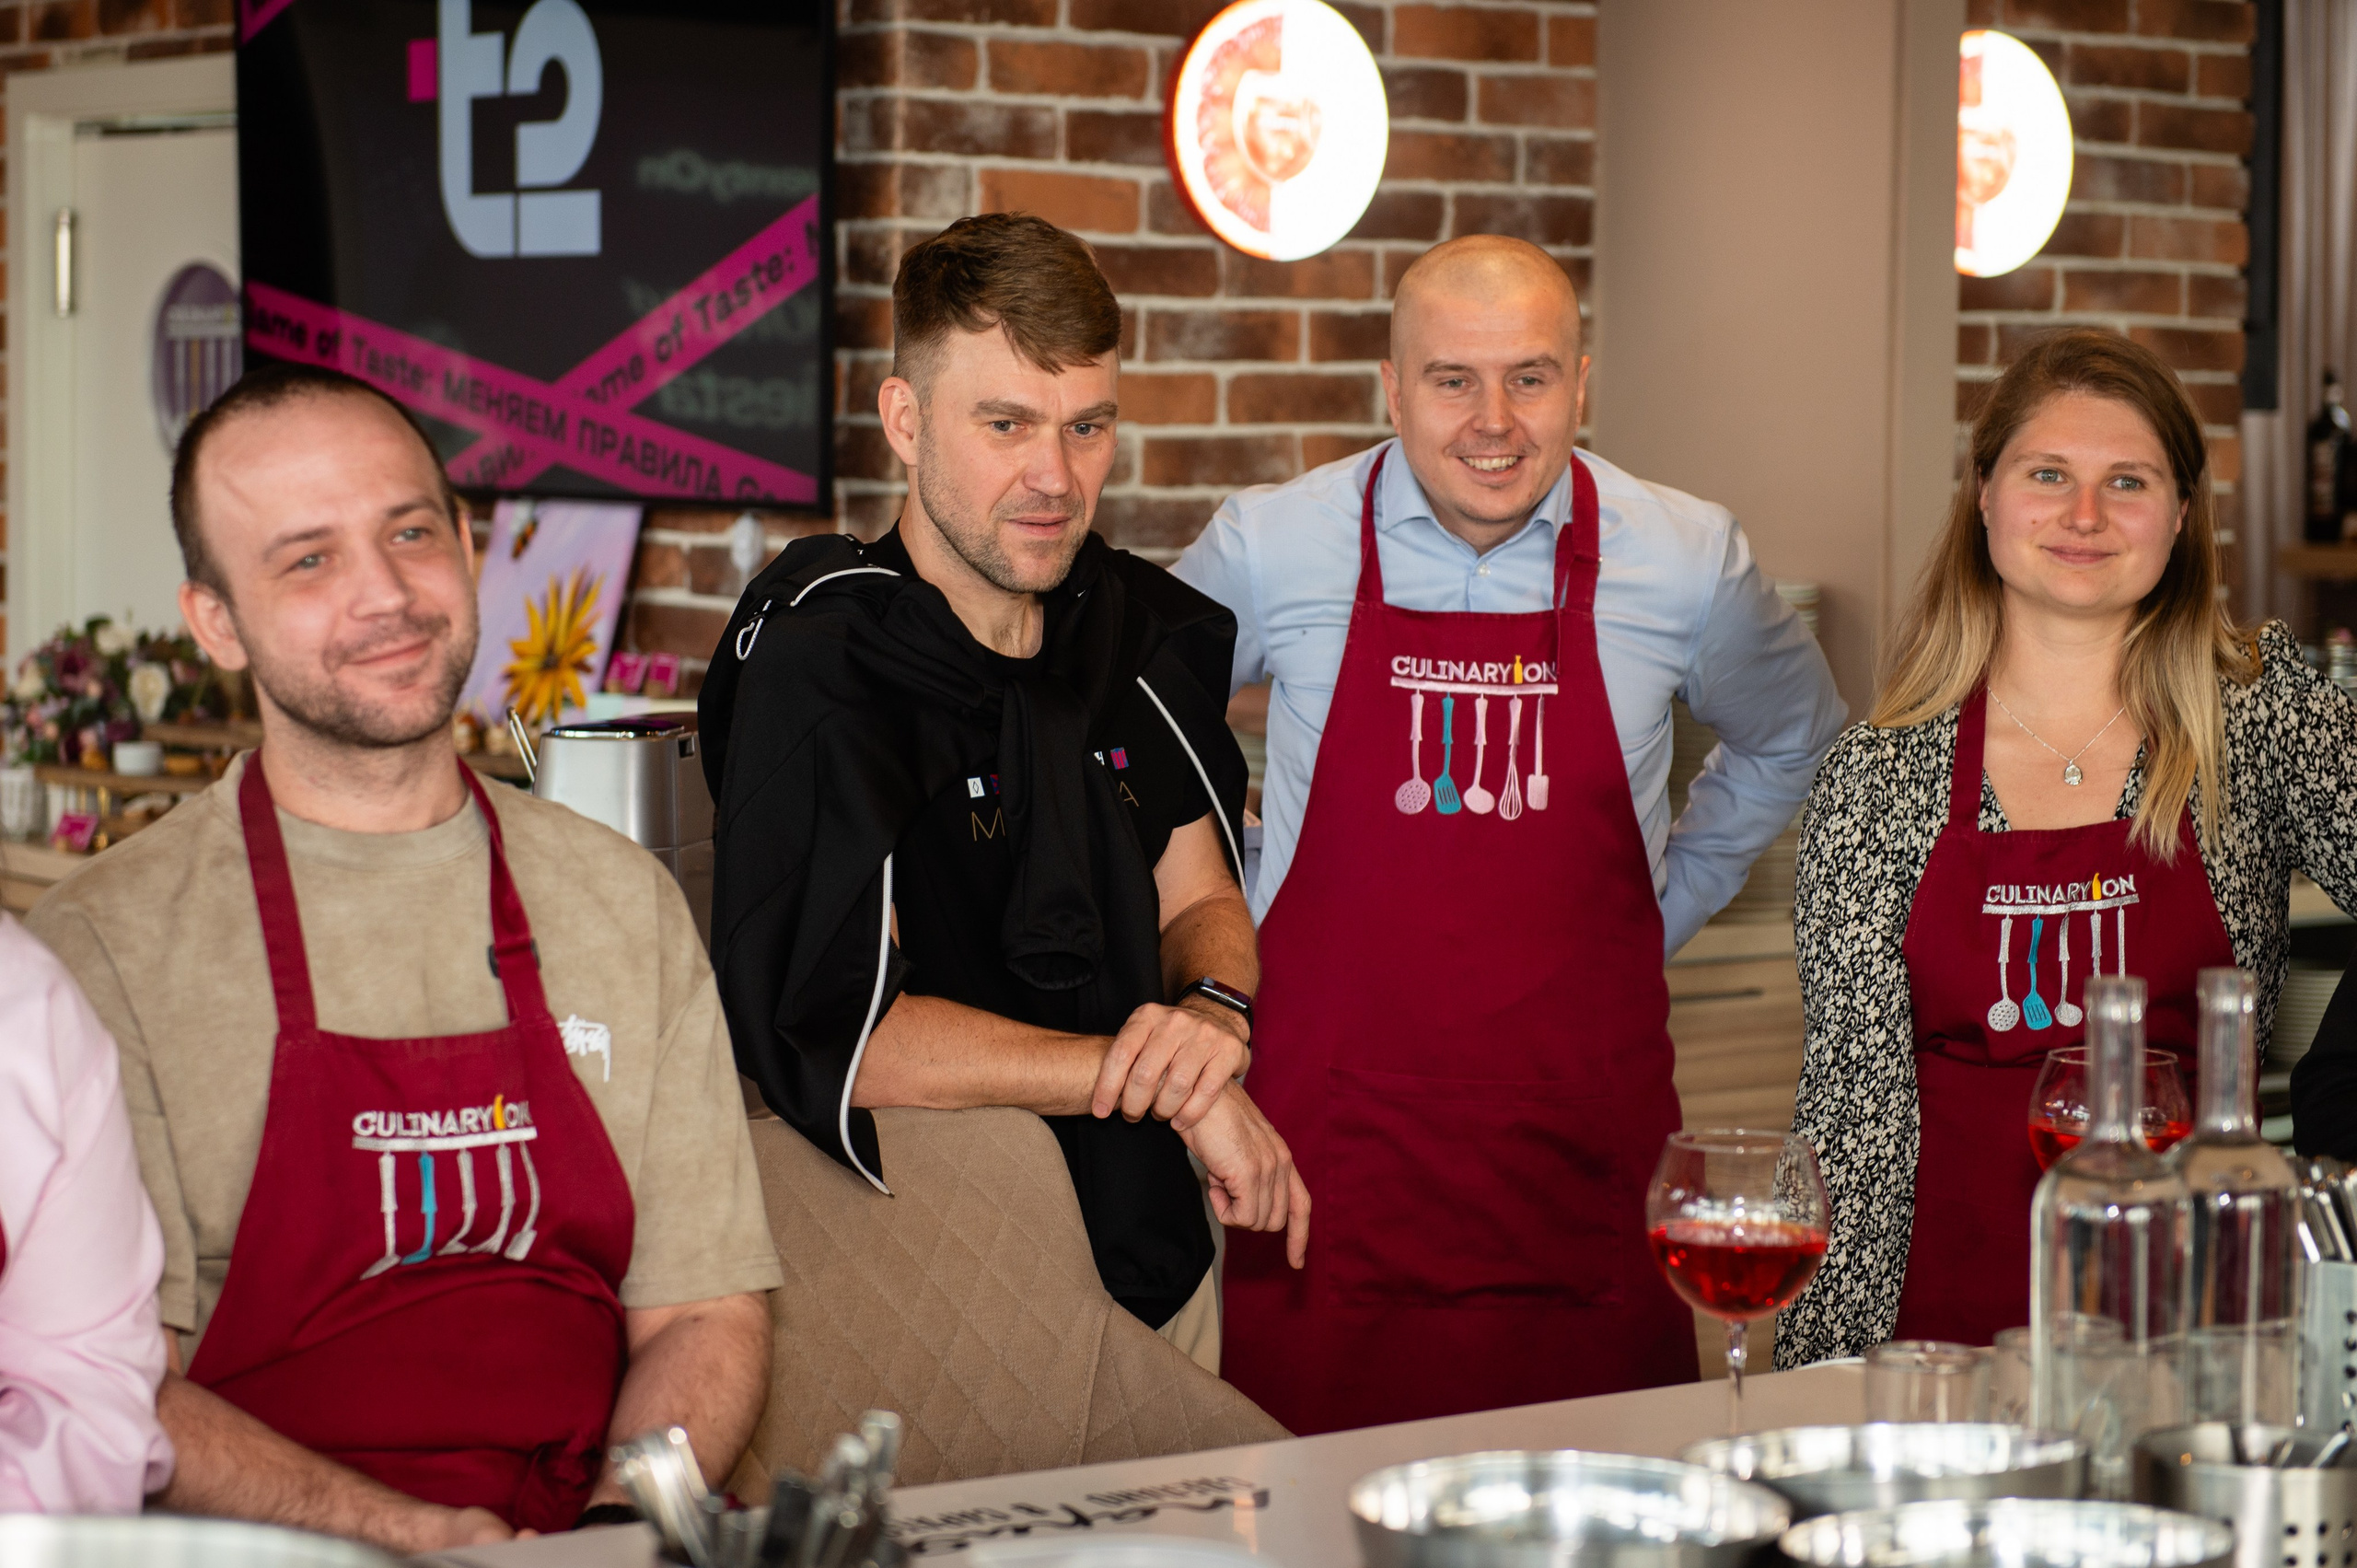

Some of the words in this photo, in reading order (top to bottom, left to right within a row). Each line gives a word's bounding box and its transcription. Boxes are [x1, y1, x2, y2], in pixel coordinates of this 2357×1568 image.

[573, 354, 645, 405] ame
[655, 312, 684, 365] of
[693, 245, 795, 333] Taste:
[316, 328, 342, 359] of
[443, 370, 567, 447] МЕНЯЕМ
[576, 417, 723, 498] ПРАВИЛА
